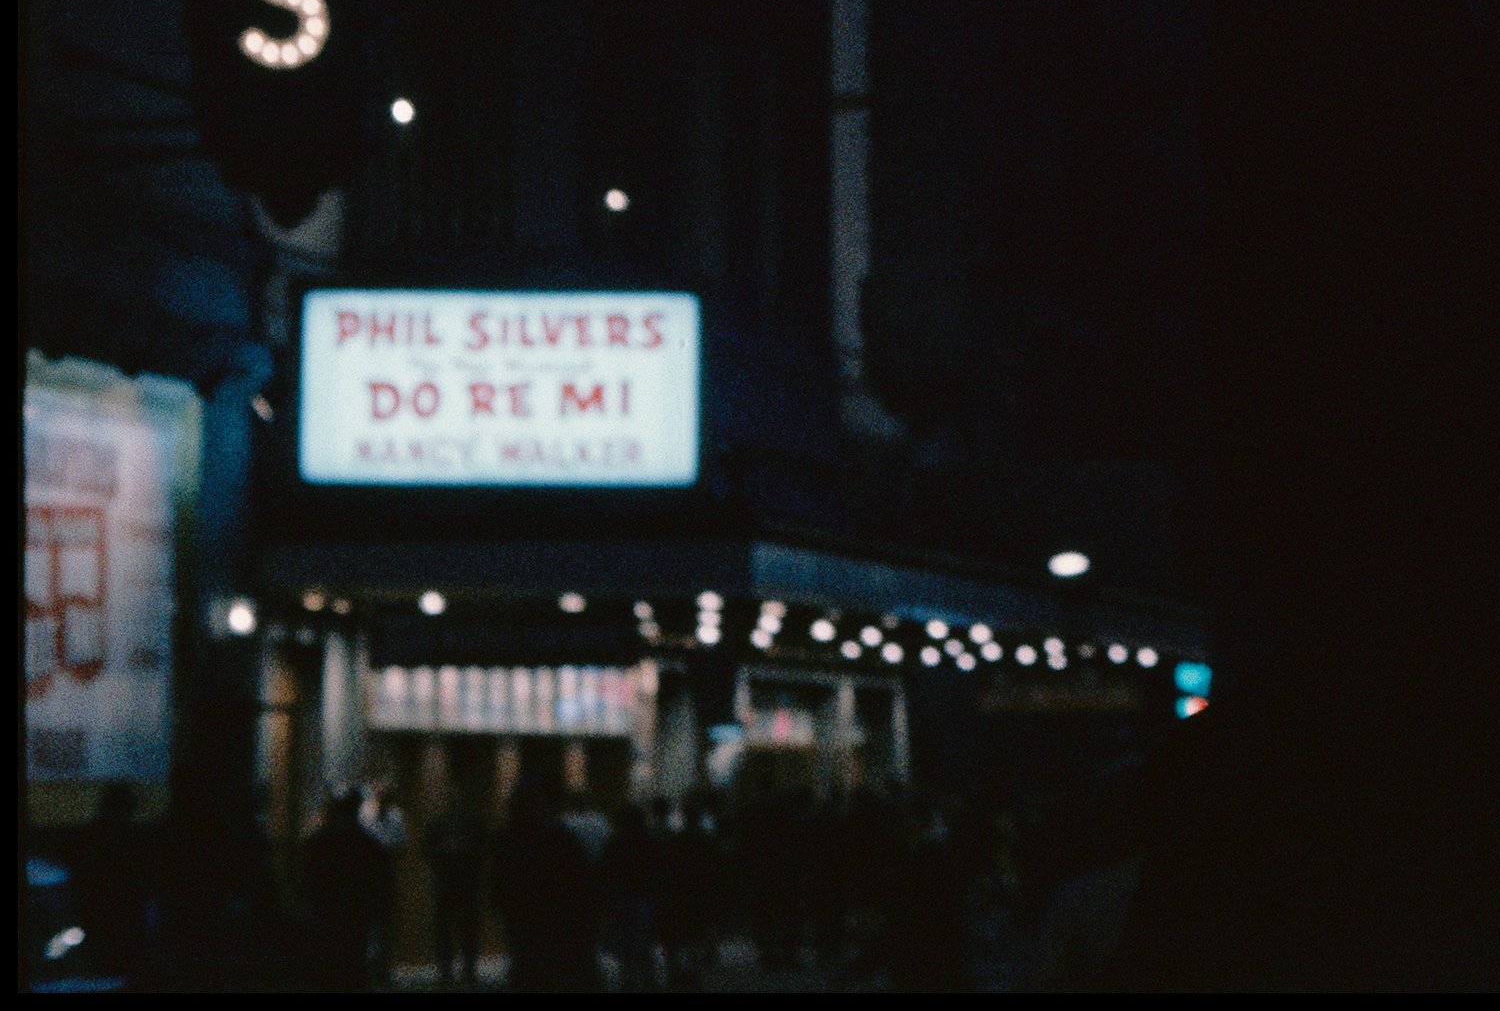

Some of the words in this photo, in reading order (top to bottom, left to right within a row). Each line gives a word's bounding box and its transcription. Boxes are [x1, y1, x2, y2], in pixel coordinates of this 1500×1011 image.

[336, 310, 440, 347] PHIL
[466, 310, 666, 350] SILVERS
[368, 380, 442, 421] DO
[468, 381, 530, 419] RE
[558, 380, 632, 418] MI
